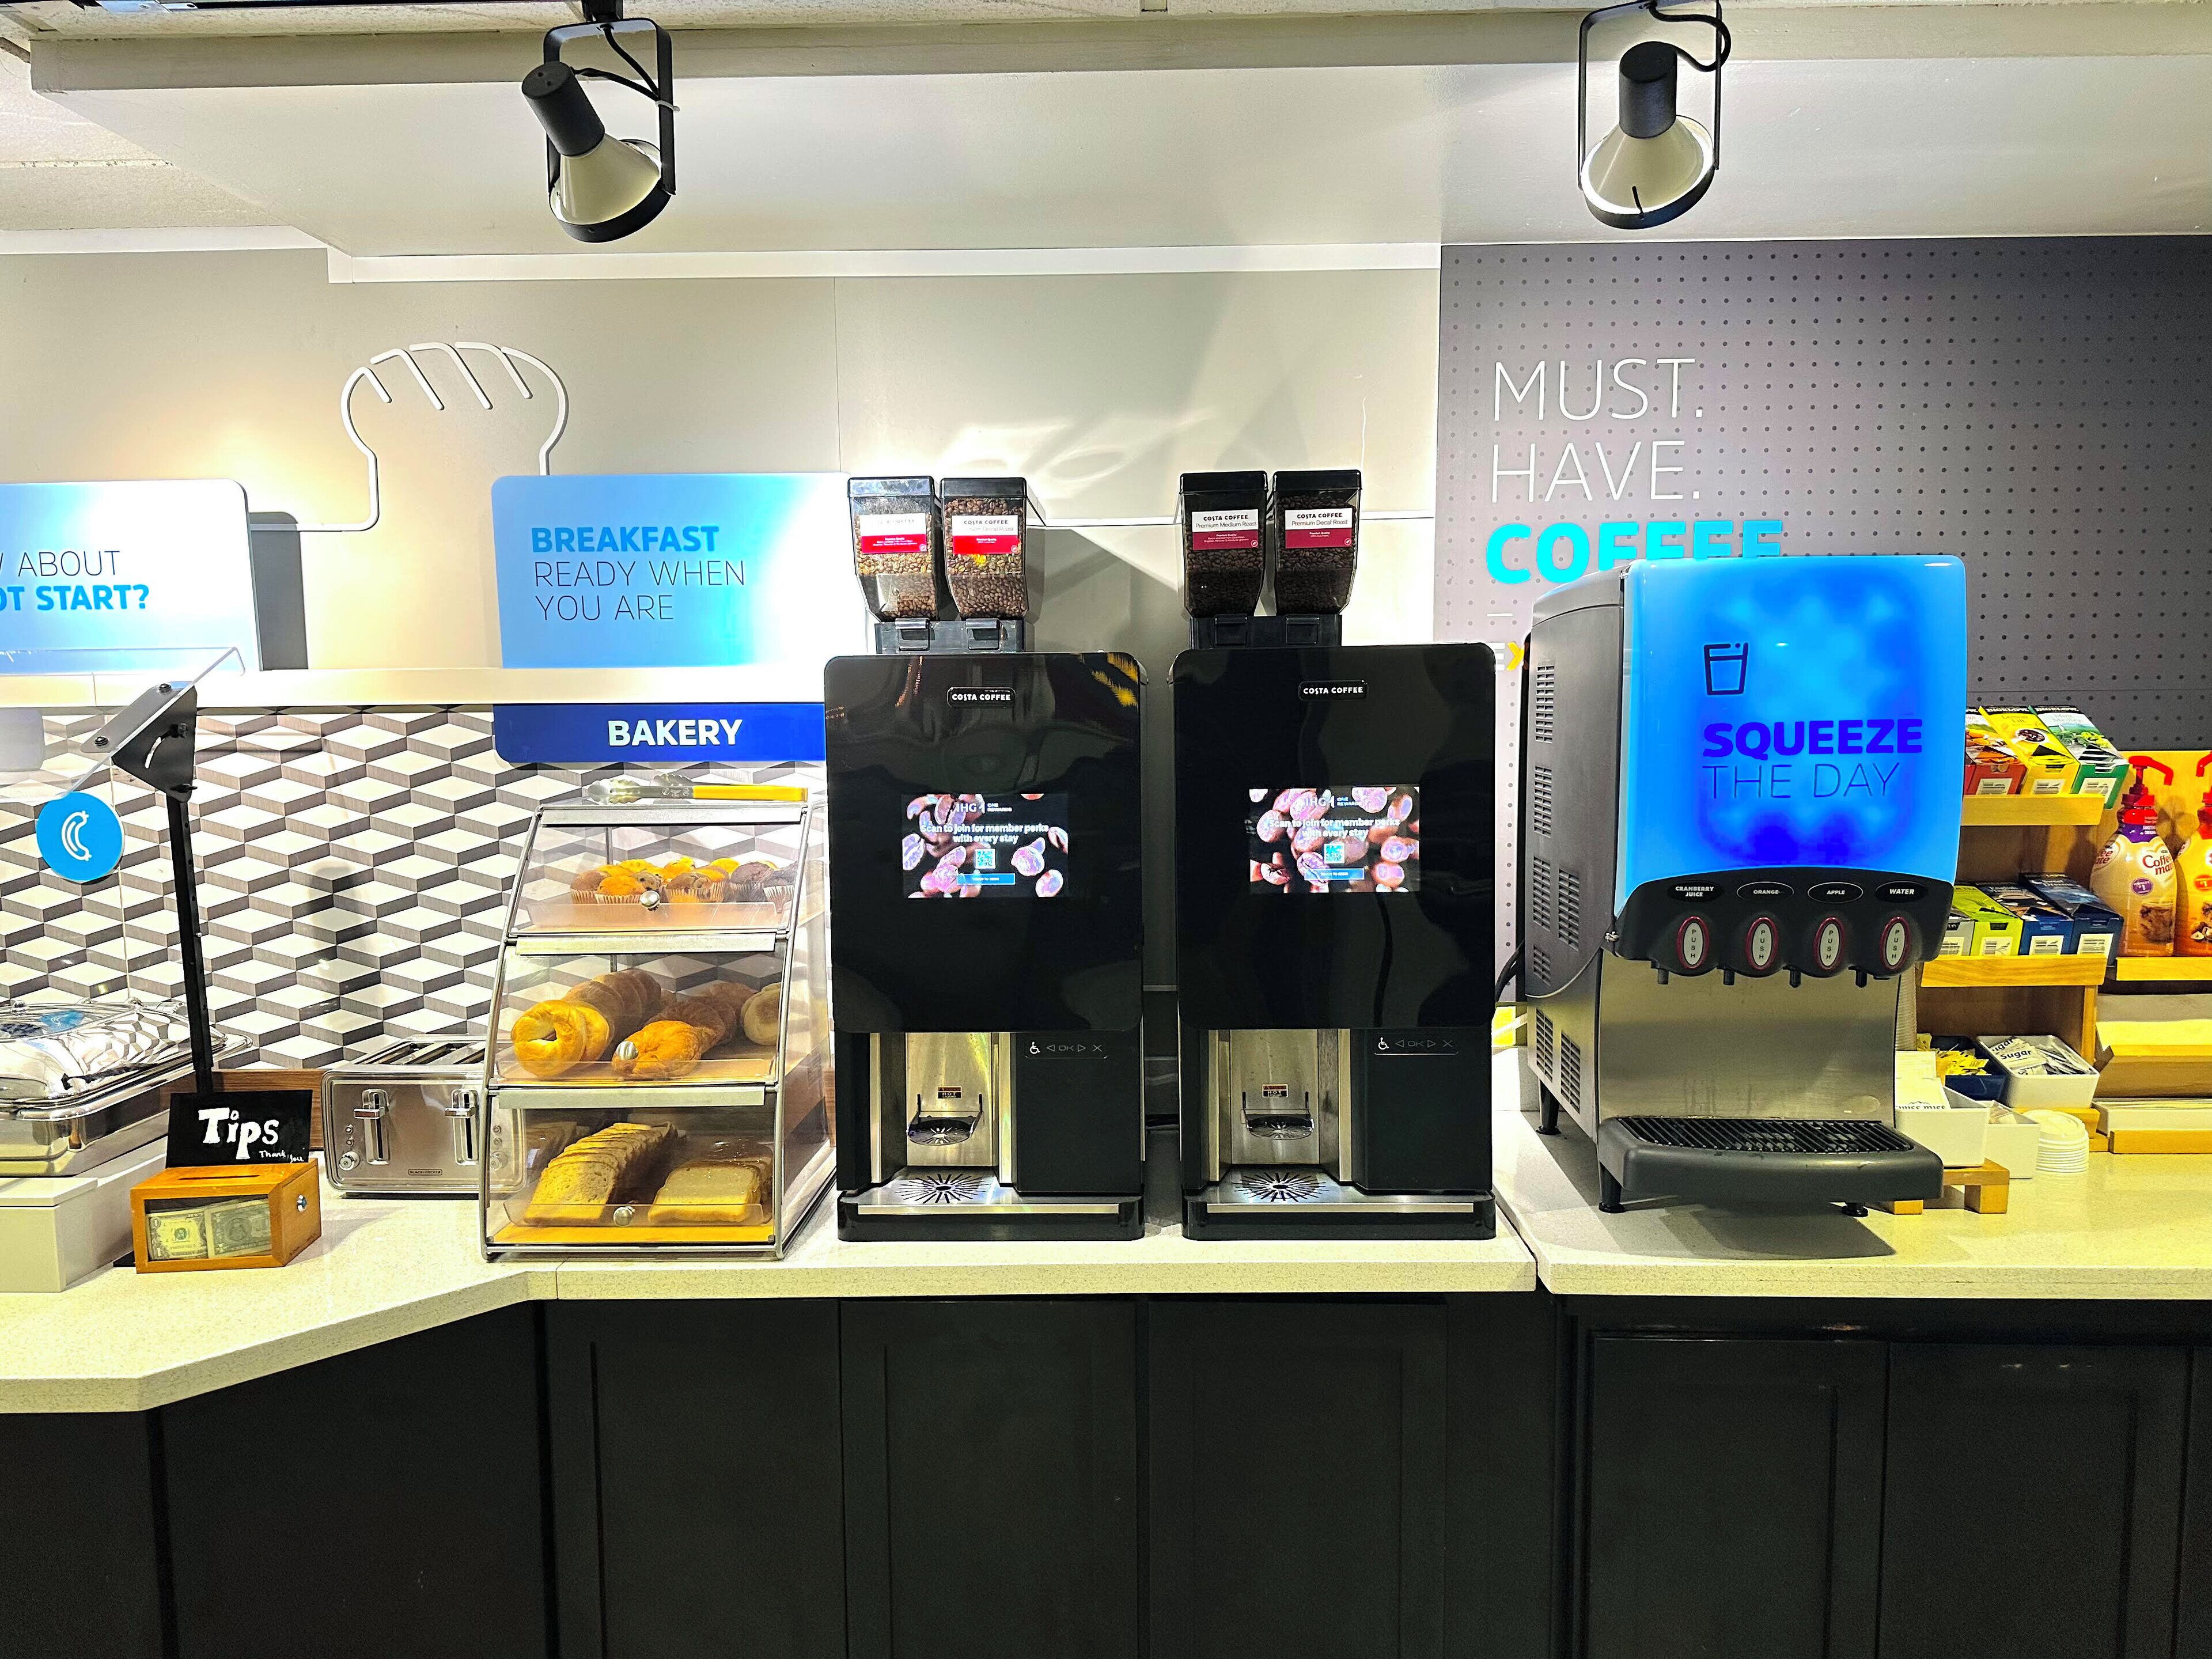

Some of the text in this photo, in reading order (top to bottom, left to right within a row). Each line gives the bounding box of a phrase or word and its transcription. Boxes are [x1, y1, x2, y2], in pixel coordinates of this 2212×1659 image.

[1494, 358, 1703, 421] MUST.
[1491, 441, 1700, 503] HAVE.
[531, 525, 719, 552] BREAKFAST
[18, 551, 120, 577] ABOUT
[535, 560, 744, 586] READY WHEN
[36, 584, 149, 611] START?
[536, 594, 673, 620] YOU ARE
[608, 719, 743, 746] BAKERY
[1703, 719, 1922, 761] SQUEEZE
[1702, 762, 1900, 799] THE DAY
[921, 823, 1049, 834] Scan to join for member perks
[1292, 819, 1302, 827] to
[1302, 819, 1320, 829] join
[1320, 818, 1334, 827] for
[1334, 818, 1374, 827] member
[1374, 818, 1400, 829] perks
[1302, 828, 1369, 839] with every stay
[953, 834, 1019, 844] with every stay
[1892, 929, 1900, 959] PUSH
[2000, 1050, 2031, 1060] Sugar
[198, 1107, 279, 1160] Tips
[259, 1150, 286, 1158] Thank
